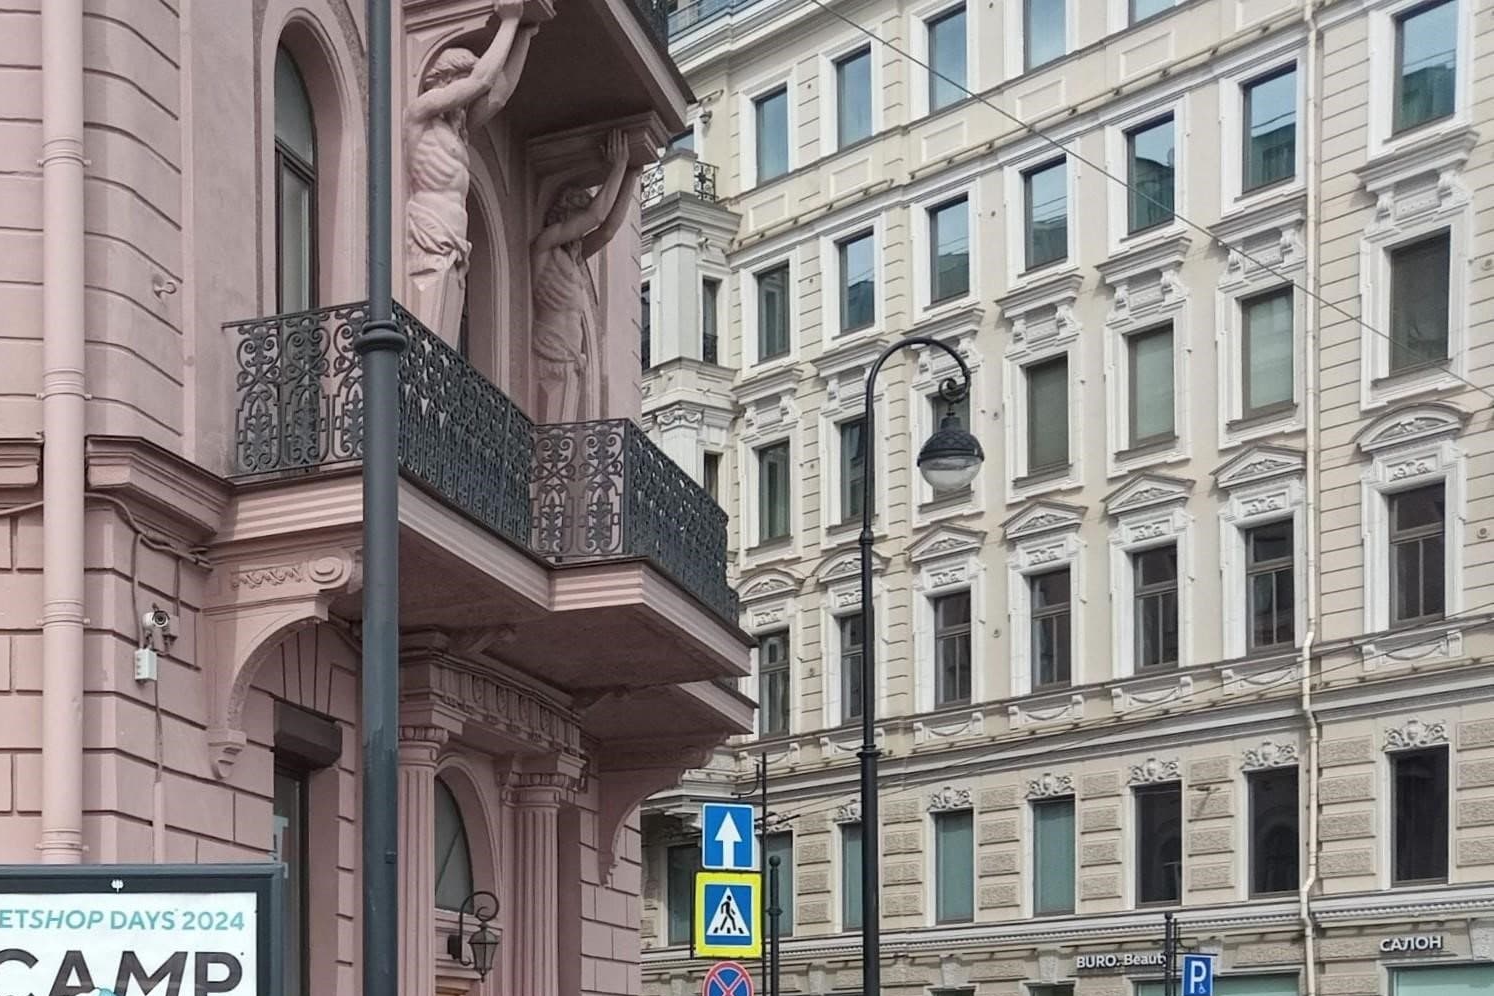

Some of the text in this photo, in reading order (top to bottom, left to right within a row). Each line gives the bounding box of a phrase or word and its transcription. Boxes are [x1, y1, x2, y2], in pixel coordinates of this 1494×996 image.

[110, 910, 175, 930] DAYS
[182, 911, 245, 931] 2024
[1380, 936, 1442, 952] САЛОН
[1124, 952, 1167, 967] Beauty
[1190, 961, 1207, 994] P
